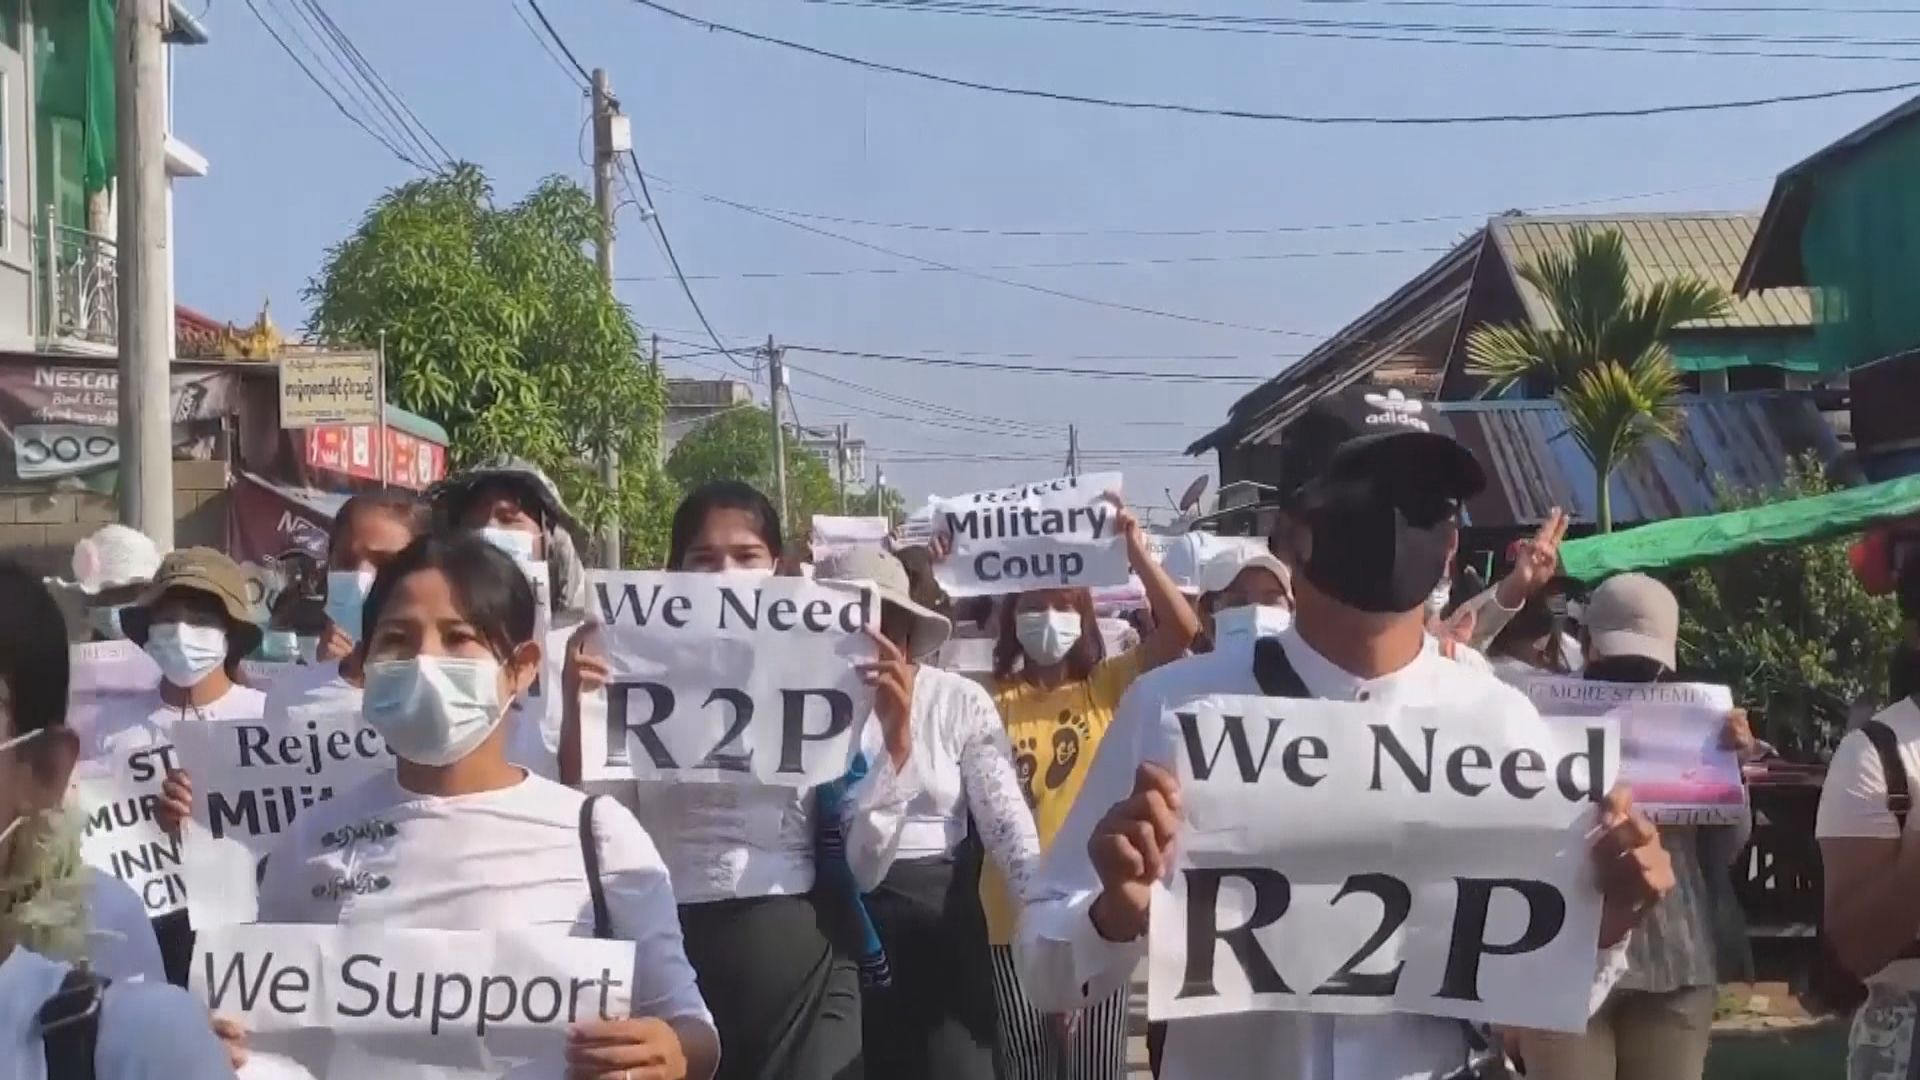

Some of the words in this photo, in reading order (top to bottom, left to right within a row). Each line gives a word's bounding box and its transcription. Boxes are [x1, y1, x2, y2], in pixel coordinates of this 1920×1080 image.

[34, 368, 118, 388] NESCAF
[1365, 409, 1430, 432] adidas
[945, 506, 1107, 539] Military
[974, 550, 1084, 584] Coup
[595, 582, 692, 628] We
[717, 586, 872, 633] Need
[235, 721, 397, 775] Rejec
[605, 681, 854, 775] R2P
[128, 744, 175, 782] ST
[1175, 712, 1328, 787] We
[1367, 724, 1605, 803] Need
[85, 794, 160, 837] MUR
[207, 786, 333, 839] Mili
[110, 832, 183, 879] INN
[1174, 867, 1567, 1001] R2P
[204, 951, 310, 1014] We
[337, 954, 622, 1036] Support
